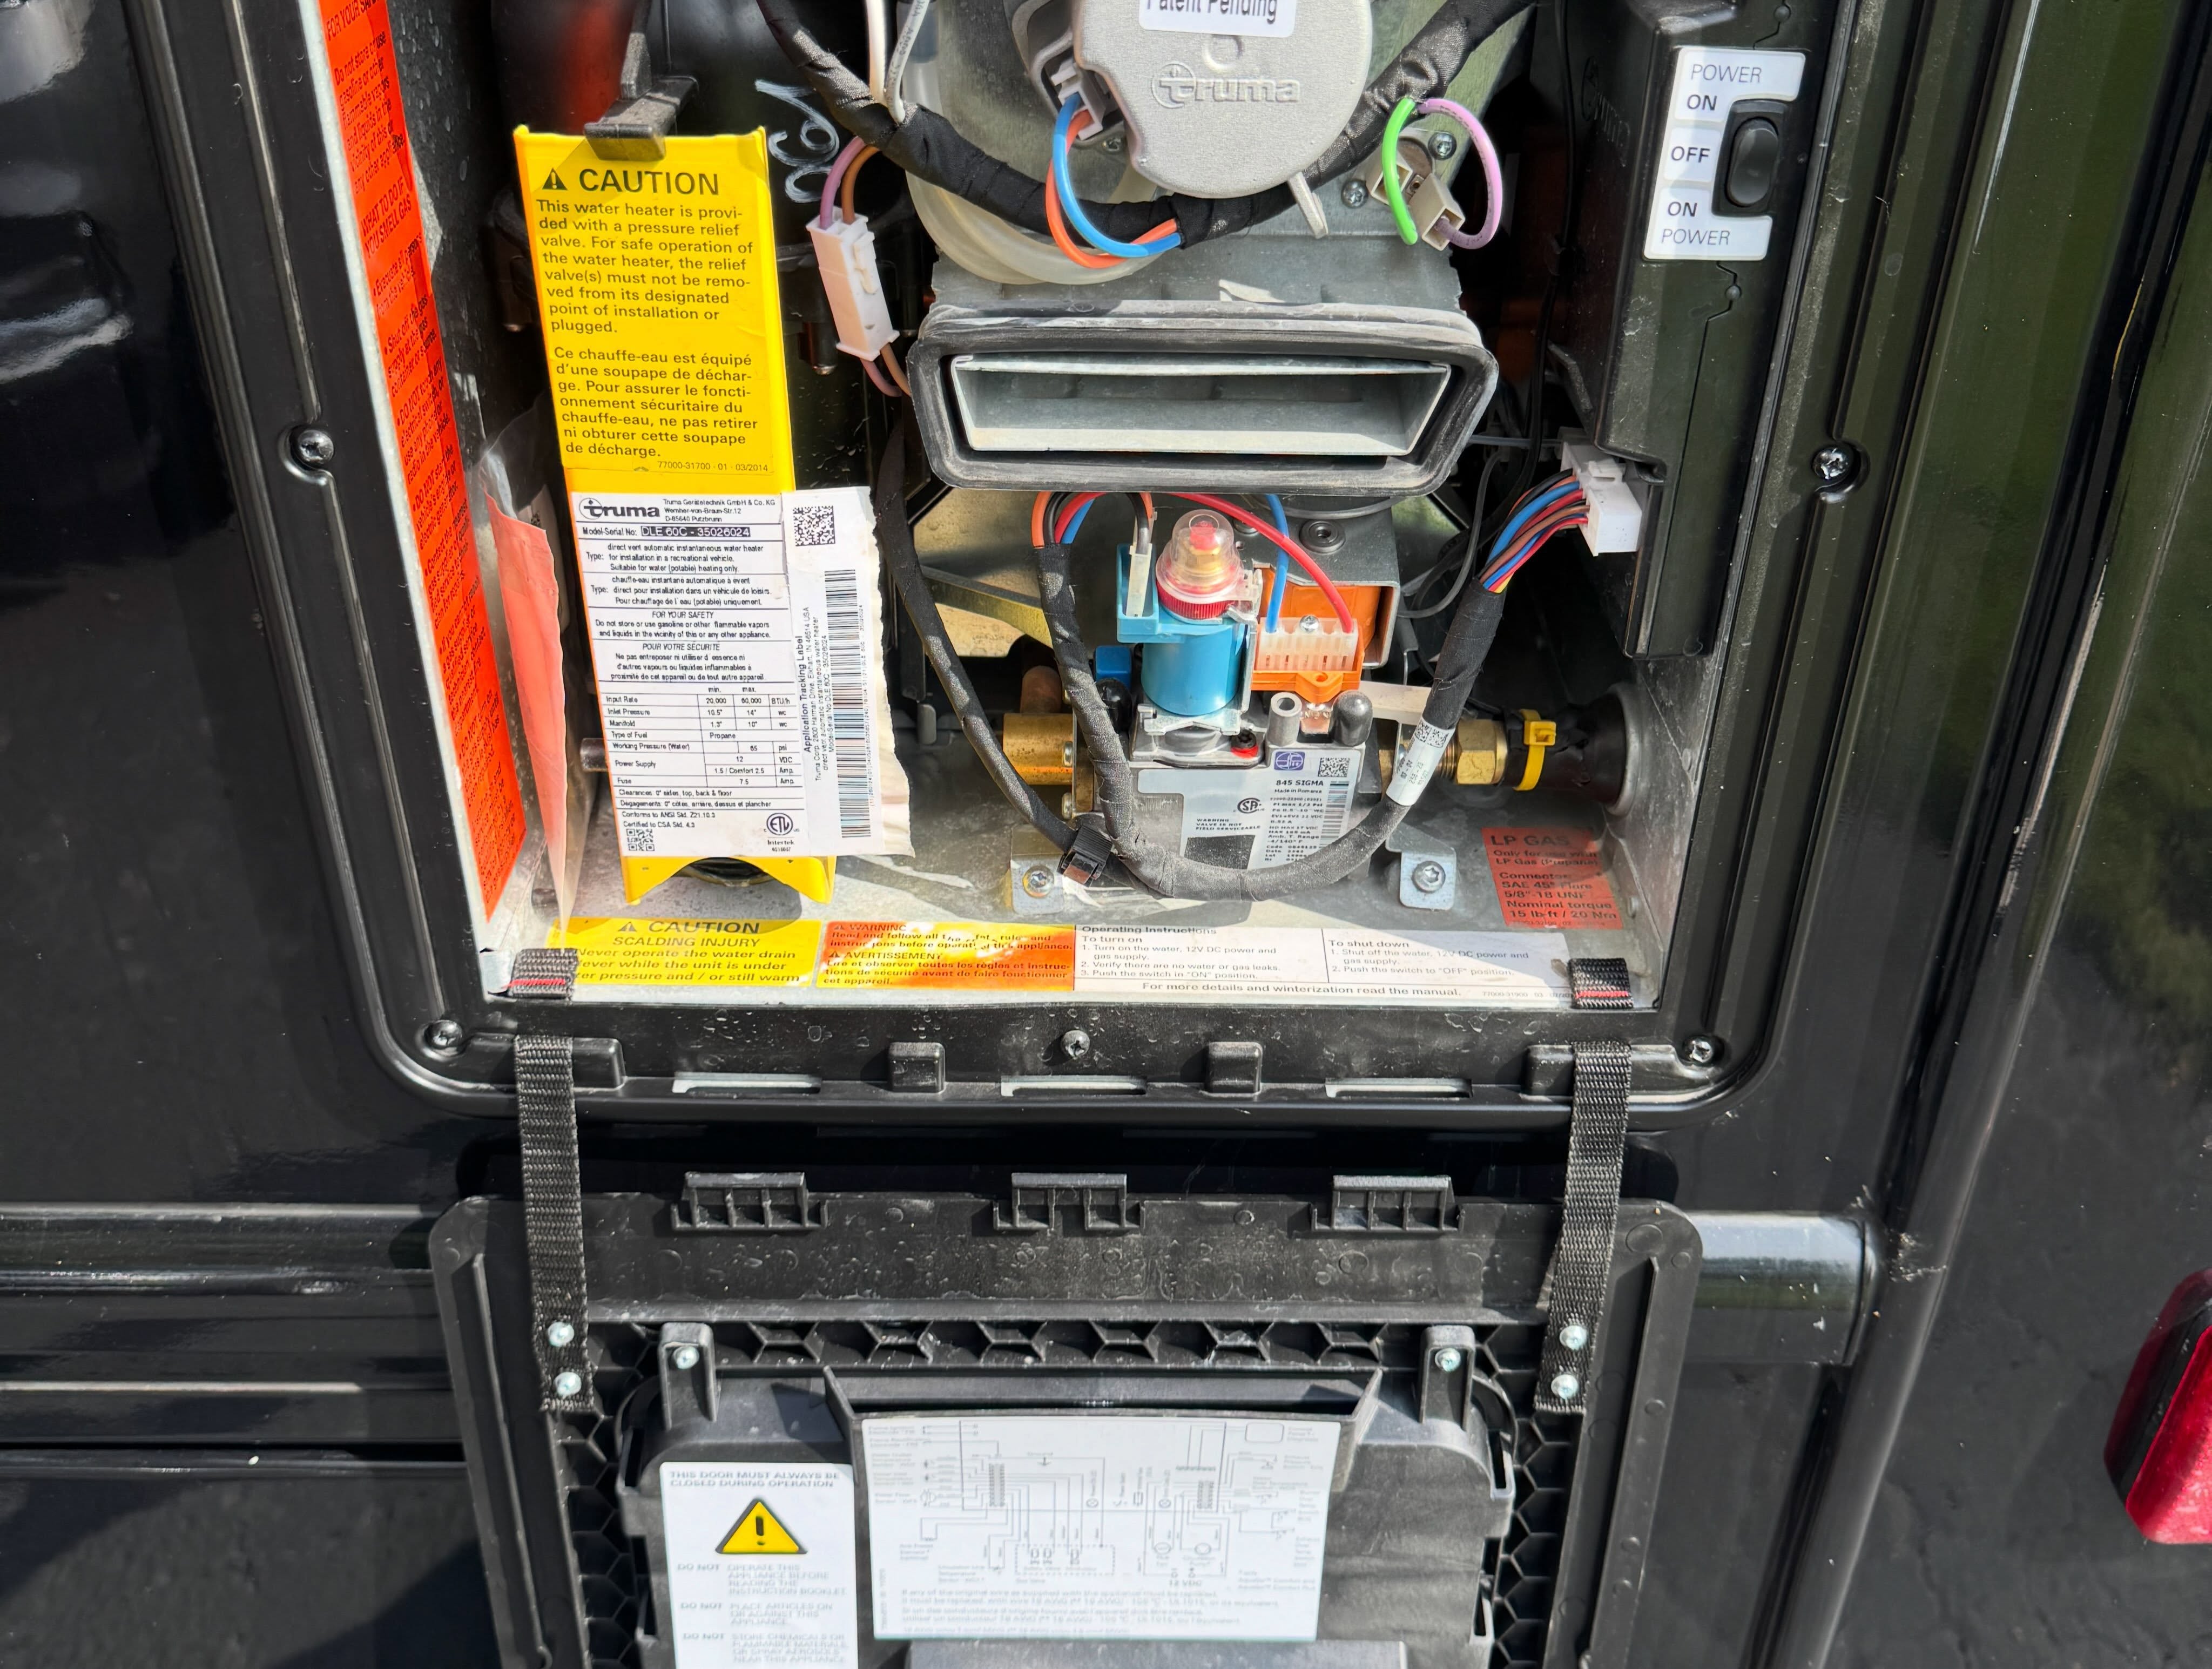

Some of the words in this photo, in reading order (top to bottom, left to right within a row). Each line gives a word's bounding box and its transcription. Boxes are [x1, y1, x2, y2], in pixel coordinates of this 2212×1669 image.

[1691, 64, 1762, 83] POWER
[1155, 66, 1302, 106] truma
[1687, 94, 1717, 111] ON
[1671, 146, 1710, 163] OFF
[579, 168, 718, 195] CAUTION
[536, 199, 569, 212] This
[574, 203, 619, 214] water
[625, 203, 675, 216] heater
[680, 208, 692, 217] is
[699, 207, 742, 220] provi-
[1668, 202, 1697, 217] ON
[539, 217, 567, 229] ded
[573, 219, 608, 231] with
[614, 223, 622, 232] a
[629, 224, 694, 235] pressure
[701, 224, 739, 235] relief
[541, 234, 585, 247] valve.
[592, 236, 616, 248] For
[621, 238, 652, 250] safe
[659, 241, 732, 254] operation
[738, 242, 752, 253] of
[1662, 229, 1730, 245] POWER
[543, 252, 567, 263] the
[573, 255, 616, 266] water
[622, 255, 673, 269] heater,
[679, 257, 703, 269] the
[709, 258, 746, 270] relief
[545, 269, 601, 284] valve(s)
[608, 274, 646, 283] must
[652, 275, 676, 285] not
[683, 274, 700, 286] be
[706, 278, 750, 287] remo-
[547, 286, 574, 298] ved
[579, 287, 615, 300] from
[621, 288, 639, 300] its
[645, 289, 729, 305] designated
[550, 303, 588, 315] point
[594, 305, 608, 315] of
[614, 305, 698, 319] installation
[704, 312, 719, 320] or
[551, 319, 617, 334] plugged.
[555, 347, 573, 359] Ce
[579, 348, 667, 362] chauffe-eau
[674, 354, 696, 363] est
[702, 353, 751, 367] équipé
[557, 363, 598, 375] d'une
[604, 368, 666, 381] soupape
[673, 368, 690, 379] de
[696, 369, 751, 381] déchar-
[558, 382, 580, 393] ge.
[586, 380, 619, 392] Pour
[625, 386, 680, 395] assurer
[685, 384, 697, 395] le
[703, 385, 750, 397] foncti-
[561, 398, 635, 409] onnement
[641, 398, 718, 412] sécuritaire
[724, 402, 742, 413] du
[562, 411, 653, 427] chauffe-eau,
[683, 419, 707, 429] pas
[714, 418, 757, 428] retirer
[564, 427, 576, 437] ni
[582, 428, 636, 440] obturer
[642, 432, 678, 441] cette
[684, 435, 745, 446] soupape
[566, 442, 583, 453] de
[589, 443, 660, 458] décharge.
[657, 461, 711, 470] 77000-31700
[641, 526, 663, 536] DLE
[665, 526, 687, 537] 60C
[697, 528, 750, 537] 35026024
[649, 921, 759, 934] CAUTION
[613, 937, 695, 946] SCALDING
[701, 938, 760, 947] INJURY
[576, 948, 618, 956] Never
[579, 960, 614, 968] ever
[619, 960, 659, 969] while
[665, 961, 688, 969] the
[693, 961, 723, 970] unit
[726, 961, 739, 970] is
[744, 962, 786, 970] under
[599, 972, 662, 981] pressure
[666, 972, 693, 981] and
[729, 972, 754, 981] still
